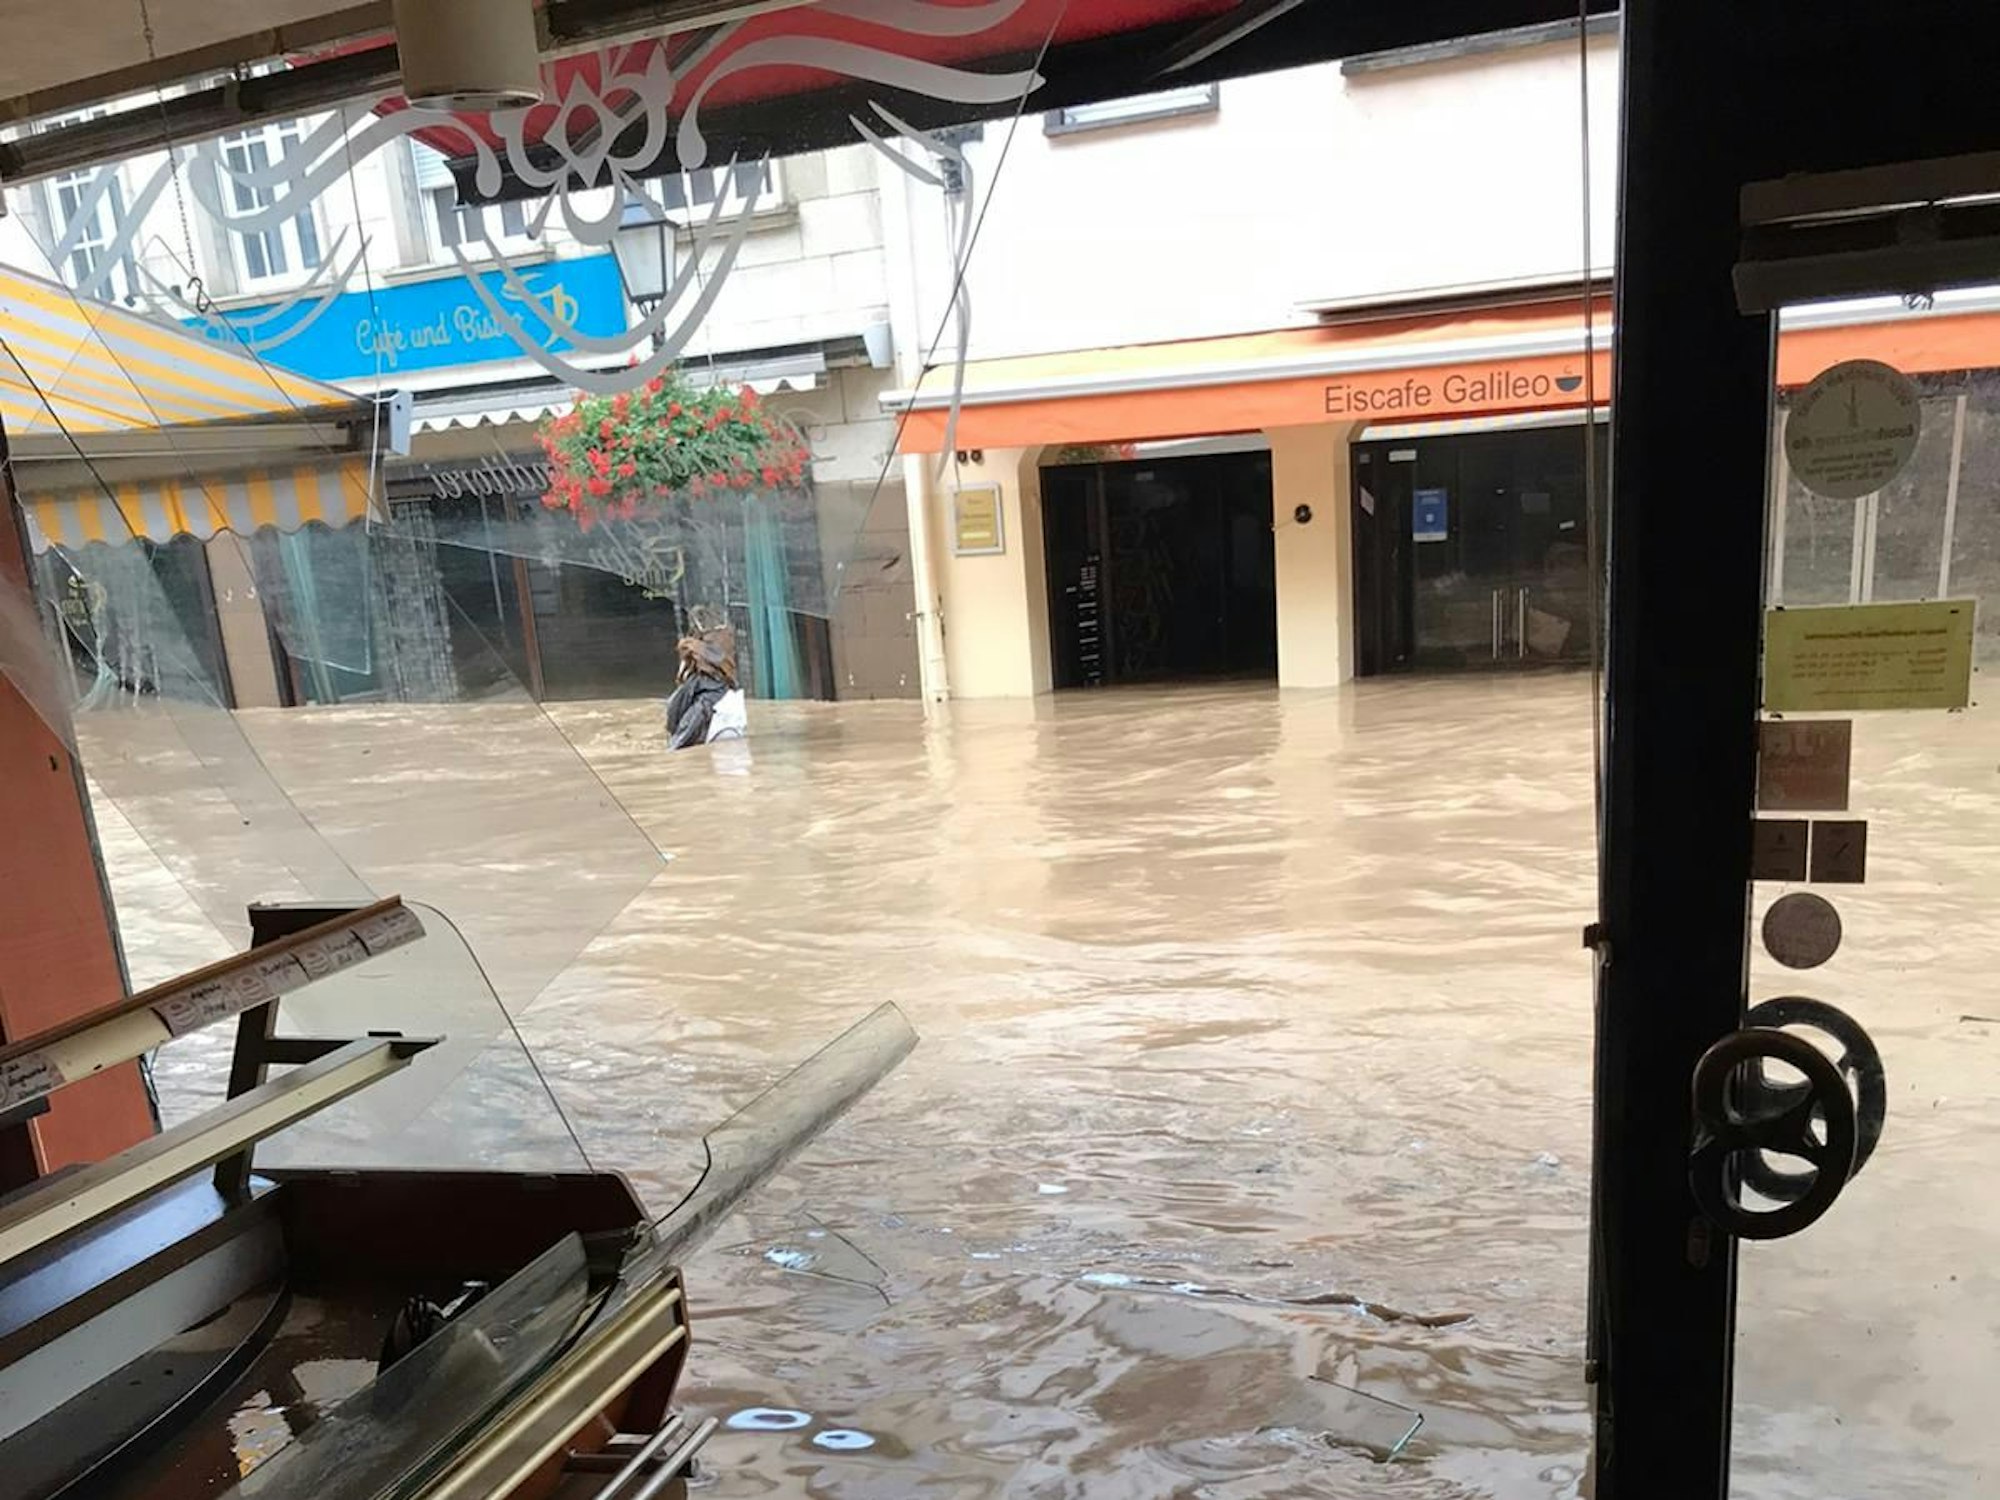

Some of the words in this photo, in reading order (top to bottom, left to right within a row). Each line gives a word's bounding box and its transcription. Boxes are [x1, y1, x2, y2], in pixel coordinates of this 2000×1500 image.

[410, 312, 451, 348] und
[1325, 378, 1432, 414] Eiscafe
[1442, 370, 1550, 404] Galileo
